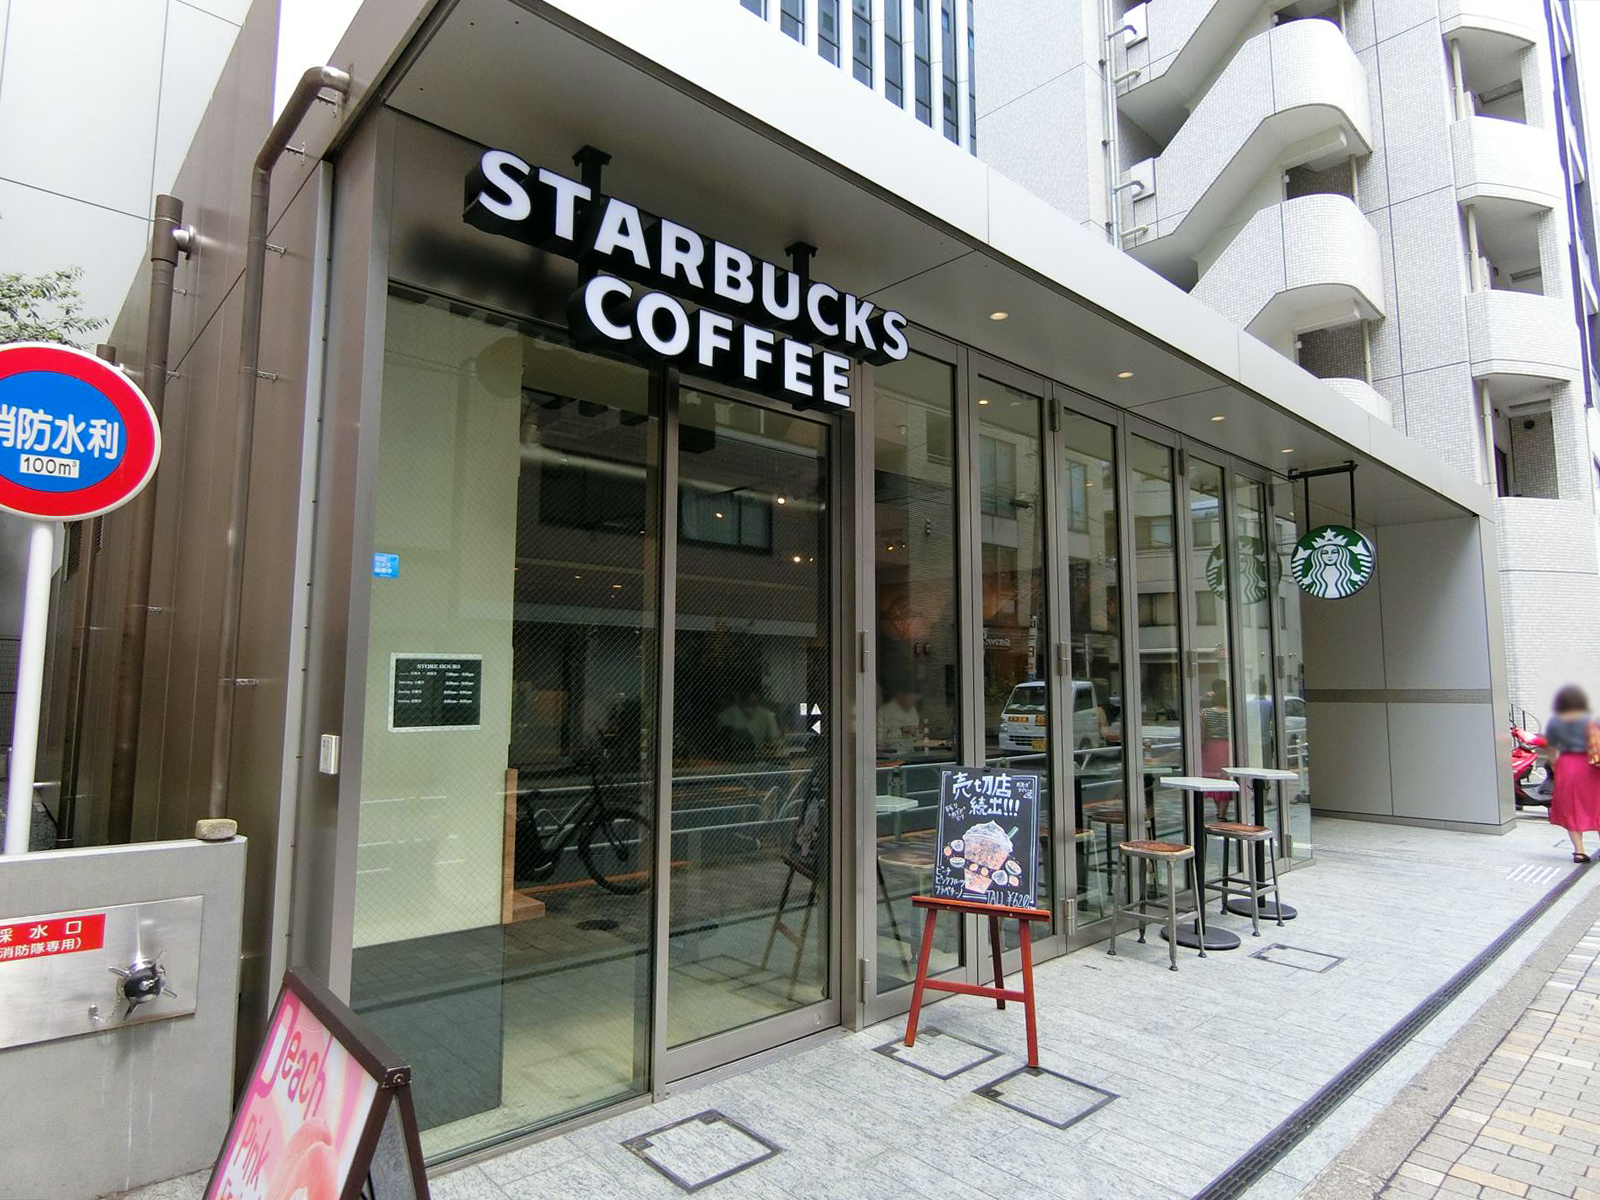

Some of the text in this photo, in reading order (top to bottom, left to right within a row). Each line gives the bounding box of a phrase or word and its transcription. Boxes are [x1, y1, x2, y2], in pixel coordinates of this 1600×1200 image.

[478, 149, 909, 361] STARBUCKS
[583, 275, 852, 408] COFFEE
[0, 403, 119, 460] 消防水利
[233, 1113, 272, 1191] Pink
